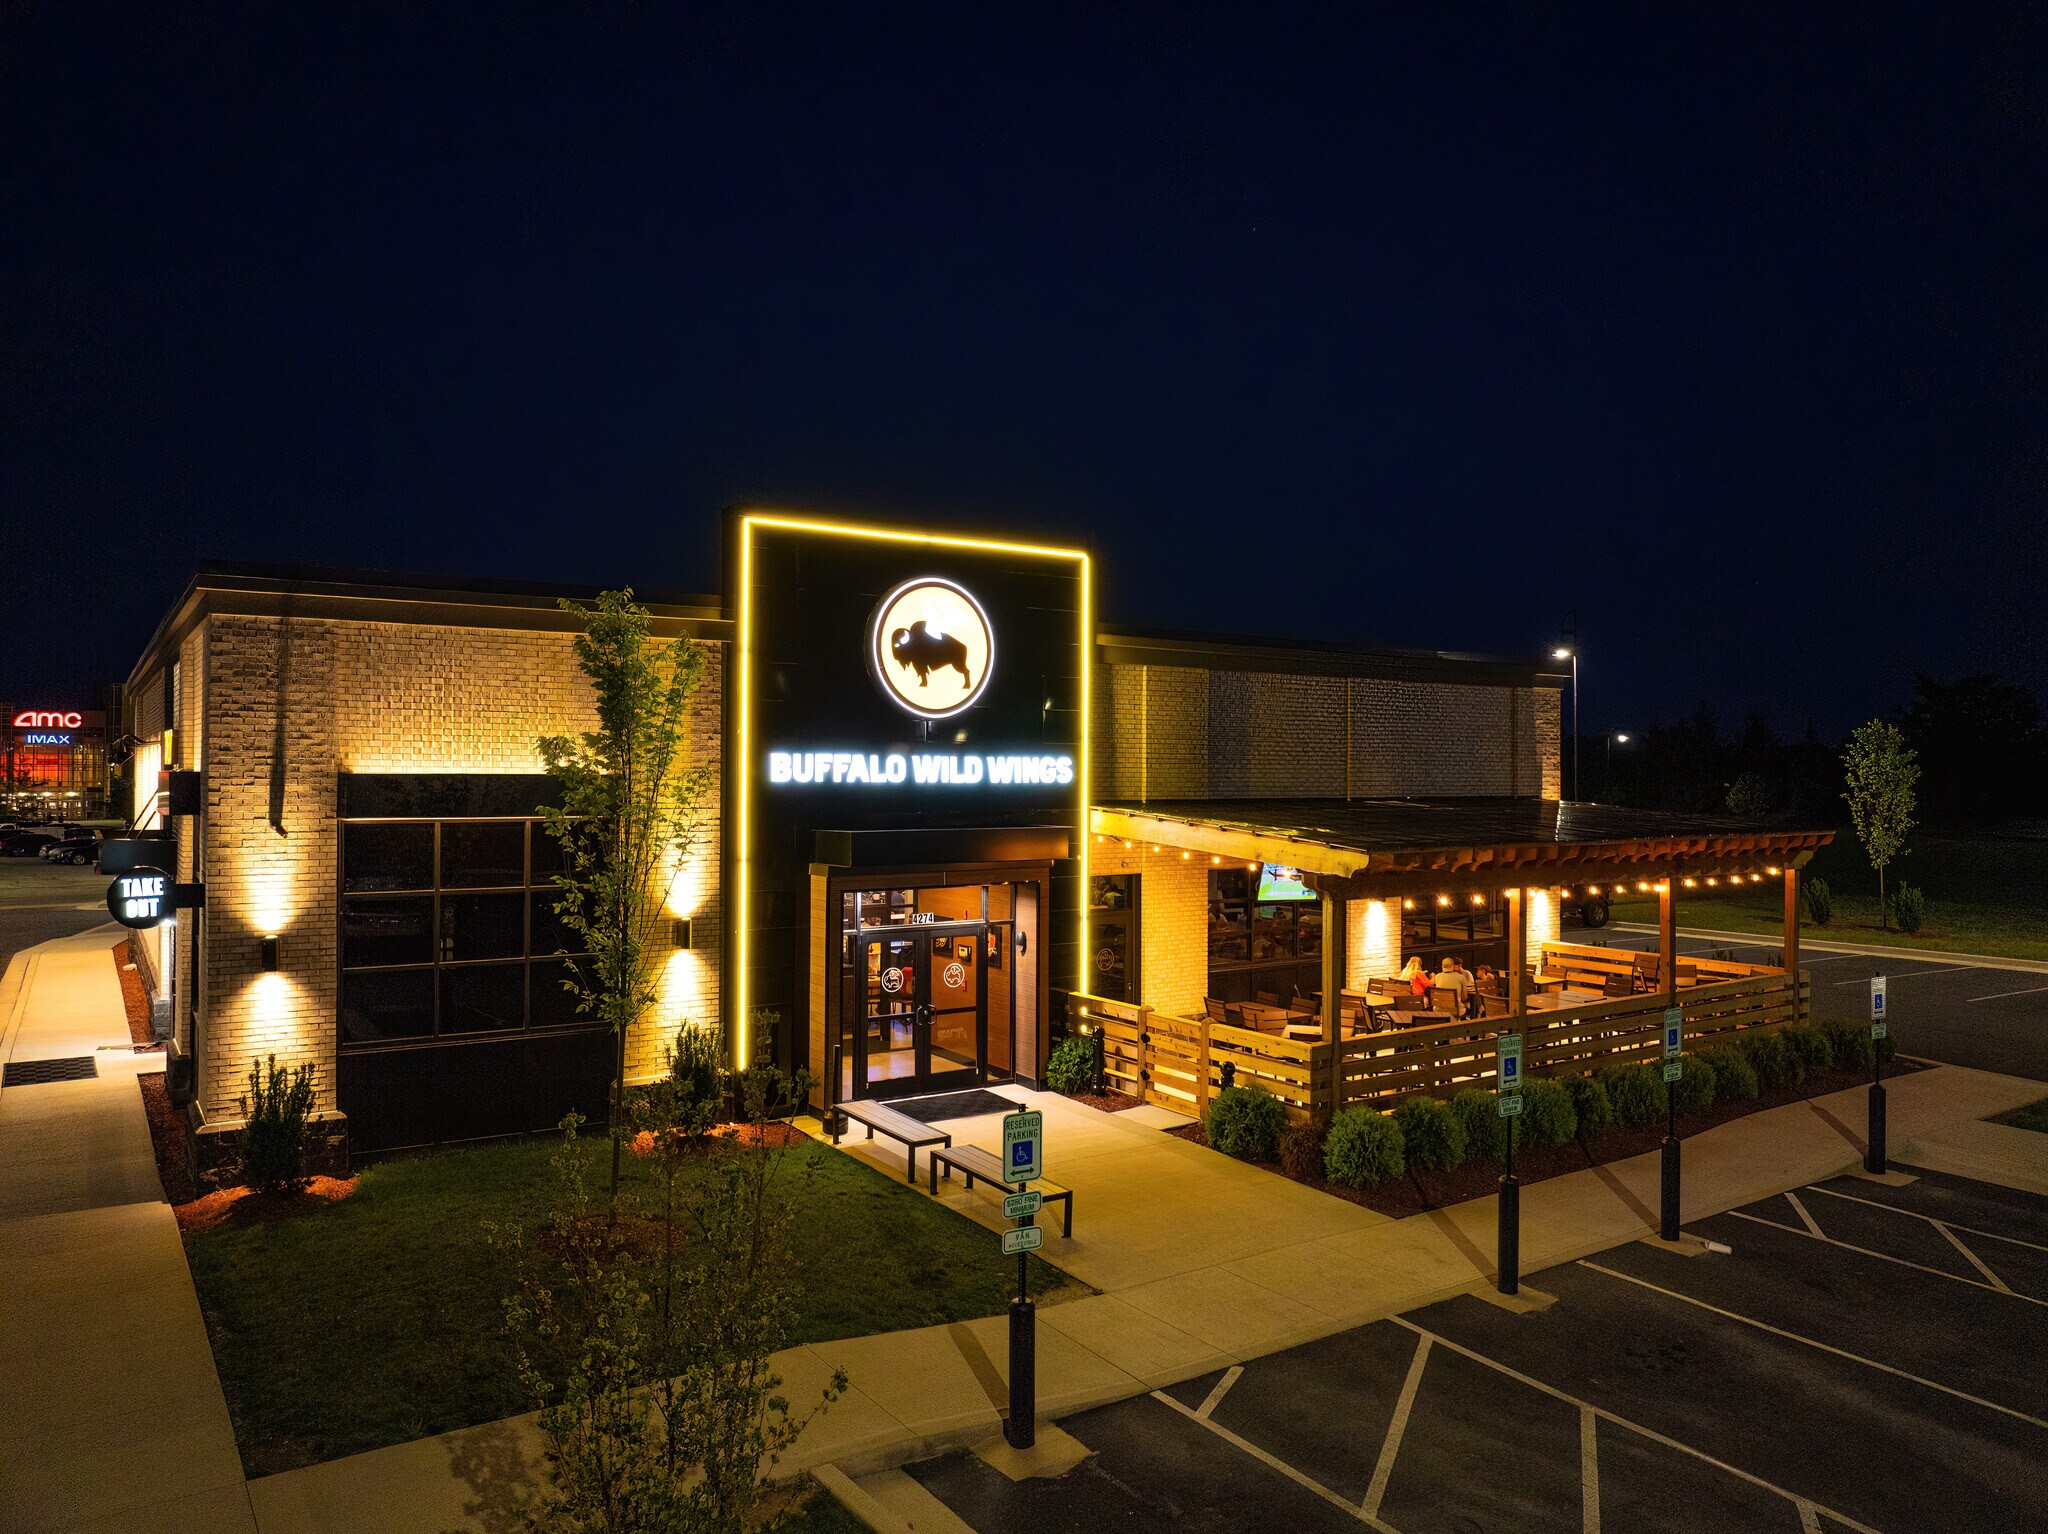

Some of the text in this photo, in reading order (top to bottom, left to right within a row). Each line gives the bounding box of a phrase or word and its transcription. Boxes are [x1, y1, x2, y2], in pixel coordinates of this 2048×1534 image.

[27, 734, 70, 744] IMAX
[769, 751, 1073, 784] BUFFALO WILD WINGS
[121, 877, 164, 897] TAKE
[126, 899, 159, 918] OUT
[913, 914, 933, 924] 4274
[1006, 1117, 1039, 1130] RESERVED
[1007, 1128, 1038, 1141] PARKING
[1025, 1195, 1038, 1203] FINE
[1015, 1232, 1030, 1240] VAN
